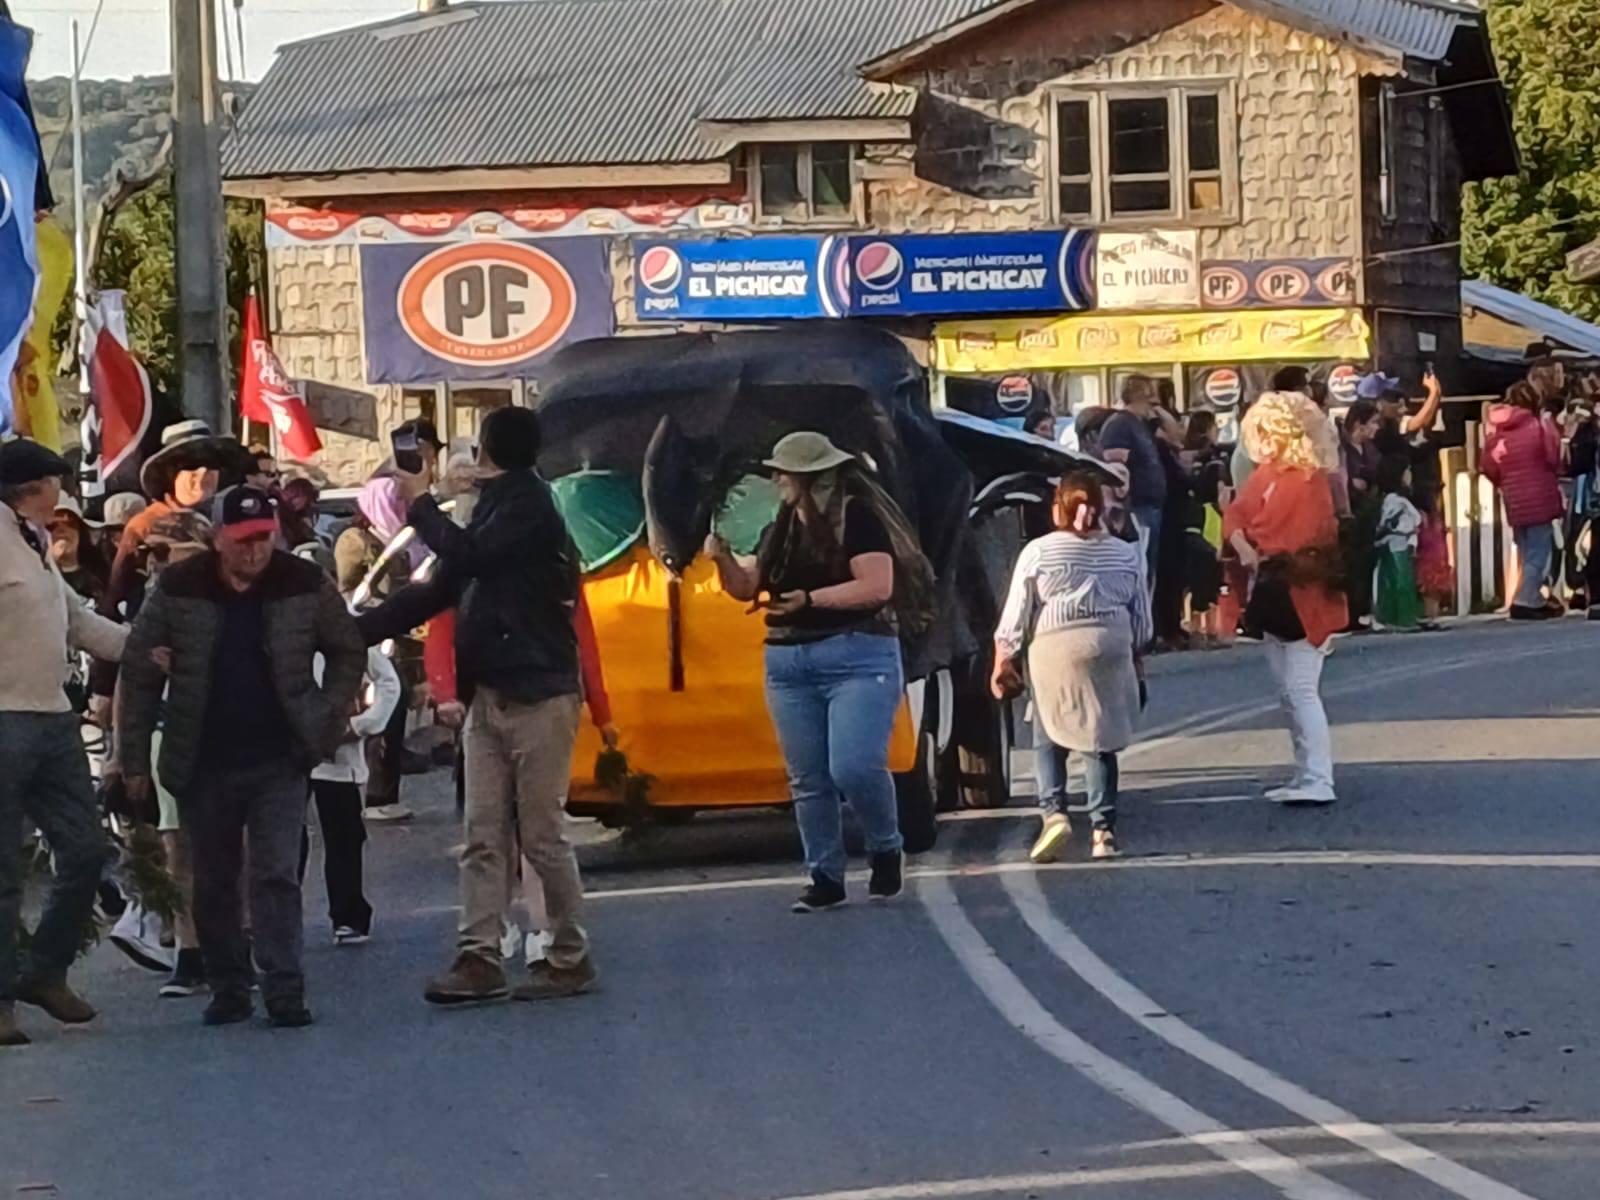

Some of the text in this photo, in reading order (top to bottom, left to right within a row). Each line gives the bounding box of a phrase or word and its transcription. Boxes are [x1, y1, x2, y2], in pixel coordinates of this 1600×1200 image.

[688, 274, 808, 297] EL PICHICAY
[912, 268, 1047, 292] EL PICHICAY
[1209, 275, 1234, 298] PF
[1270, 273, 1295, 296] PF
[443, 264, 529, 339] PF
